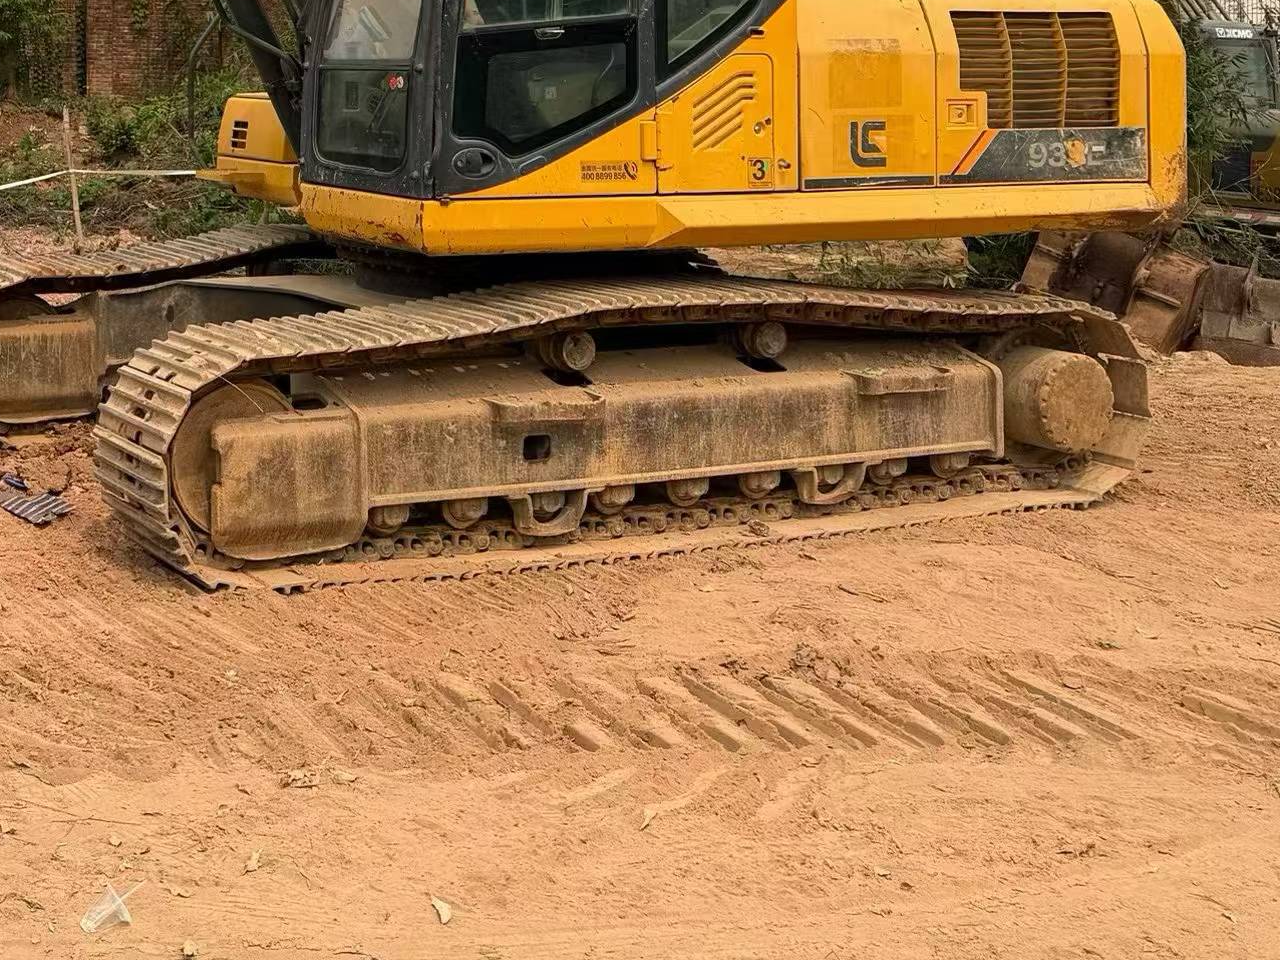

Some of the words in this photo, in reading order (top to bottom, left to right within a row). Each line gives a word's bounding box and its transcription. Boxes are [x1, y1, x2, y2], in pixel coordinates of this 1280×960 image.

[1225, 28, 1253, 39] XCMG
[1028, 140, 1106, 168] 93E
[581, 172, 595, 181] 400
[752, 159, 766, 181] 3
